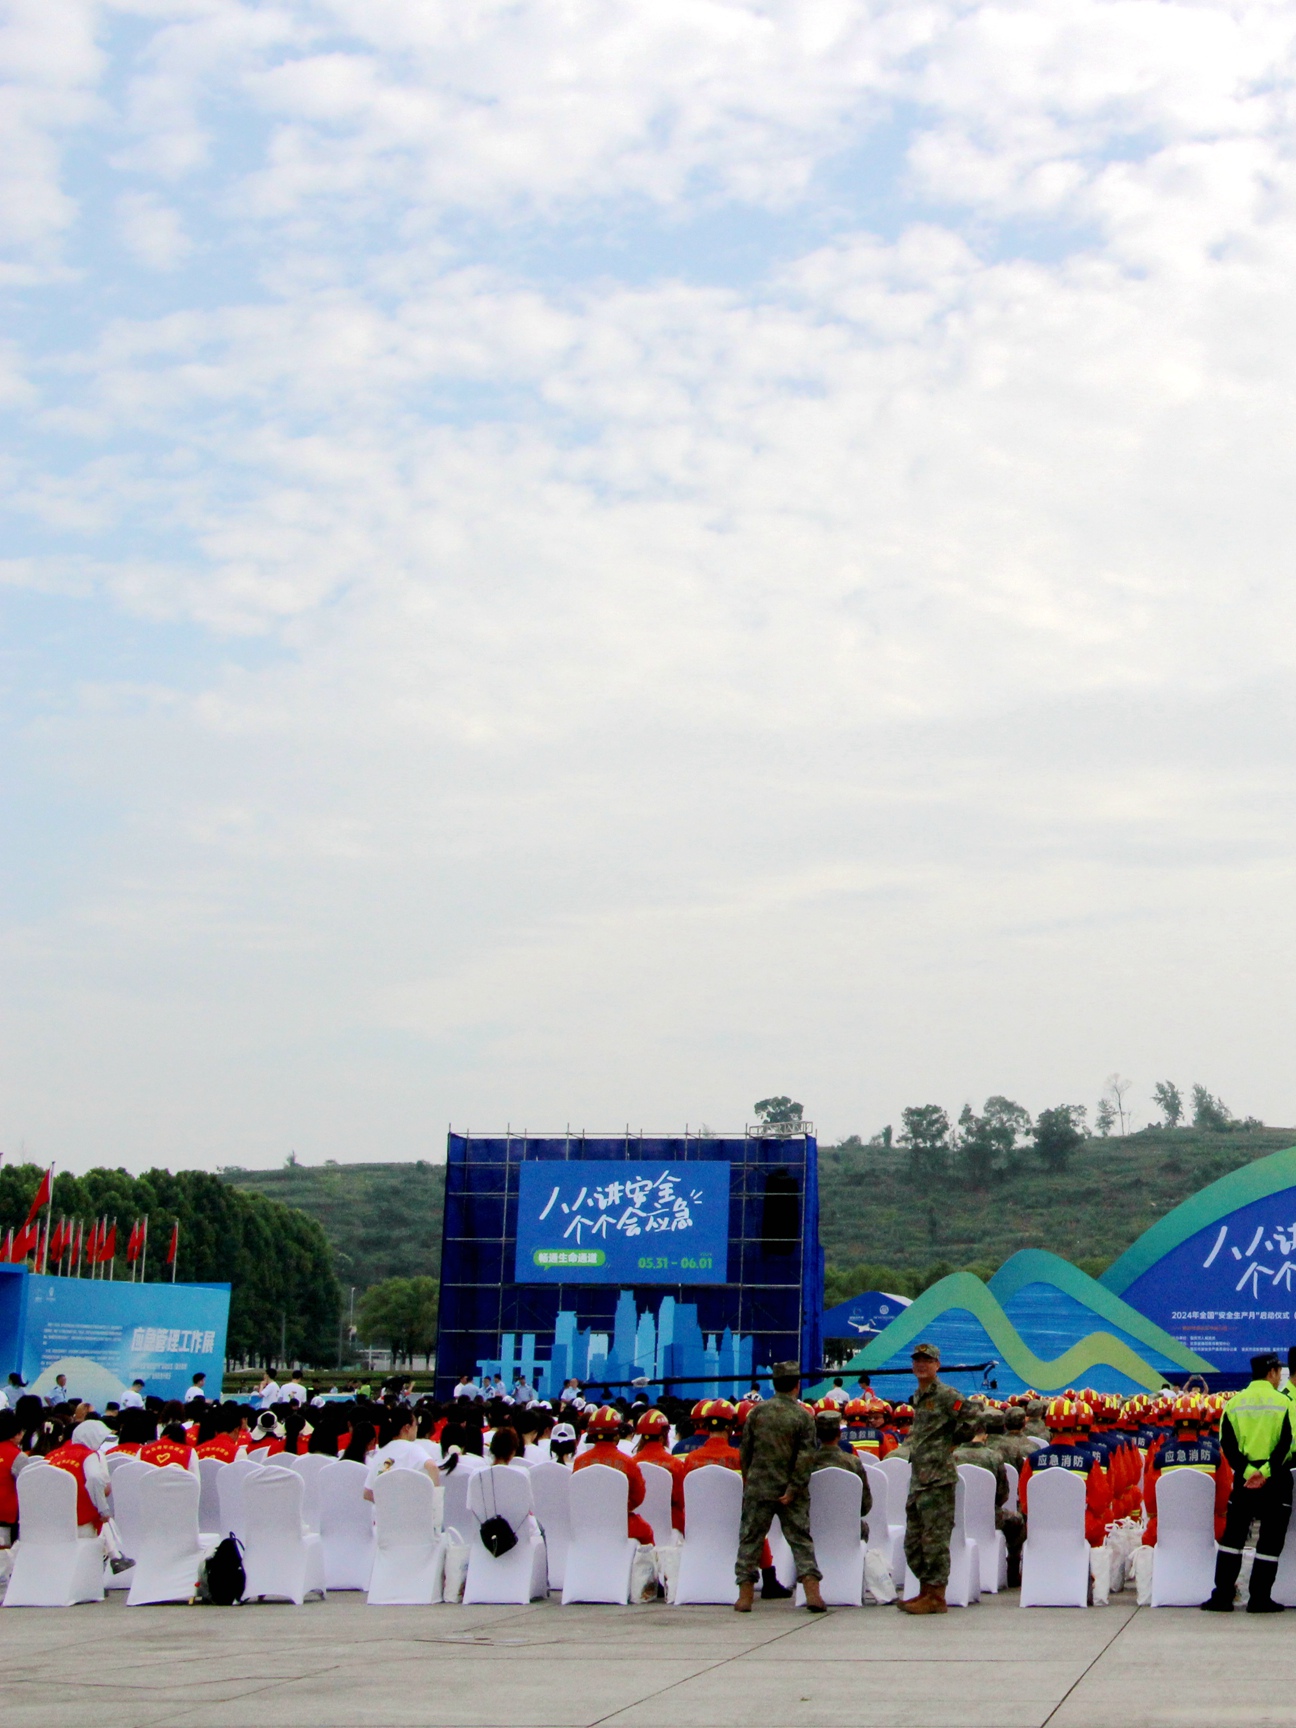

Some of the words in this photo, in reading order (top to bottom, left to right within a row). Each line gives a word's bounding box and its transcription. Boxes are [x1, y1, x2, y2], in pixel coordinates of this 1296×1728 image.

[539, 1169, 682, 1221] 人人讲安全
[563, 1196, 693, 1245] 个个会应急
[538, 1252, 598, 1264] 畅通生命通道
[131, 1327, 216, 1354] 应急管理工作展
[1037, 1453, 1084, 1468] 应急消防
[1165, 1449, 1211, 1463] 应急消防
